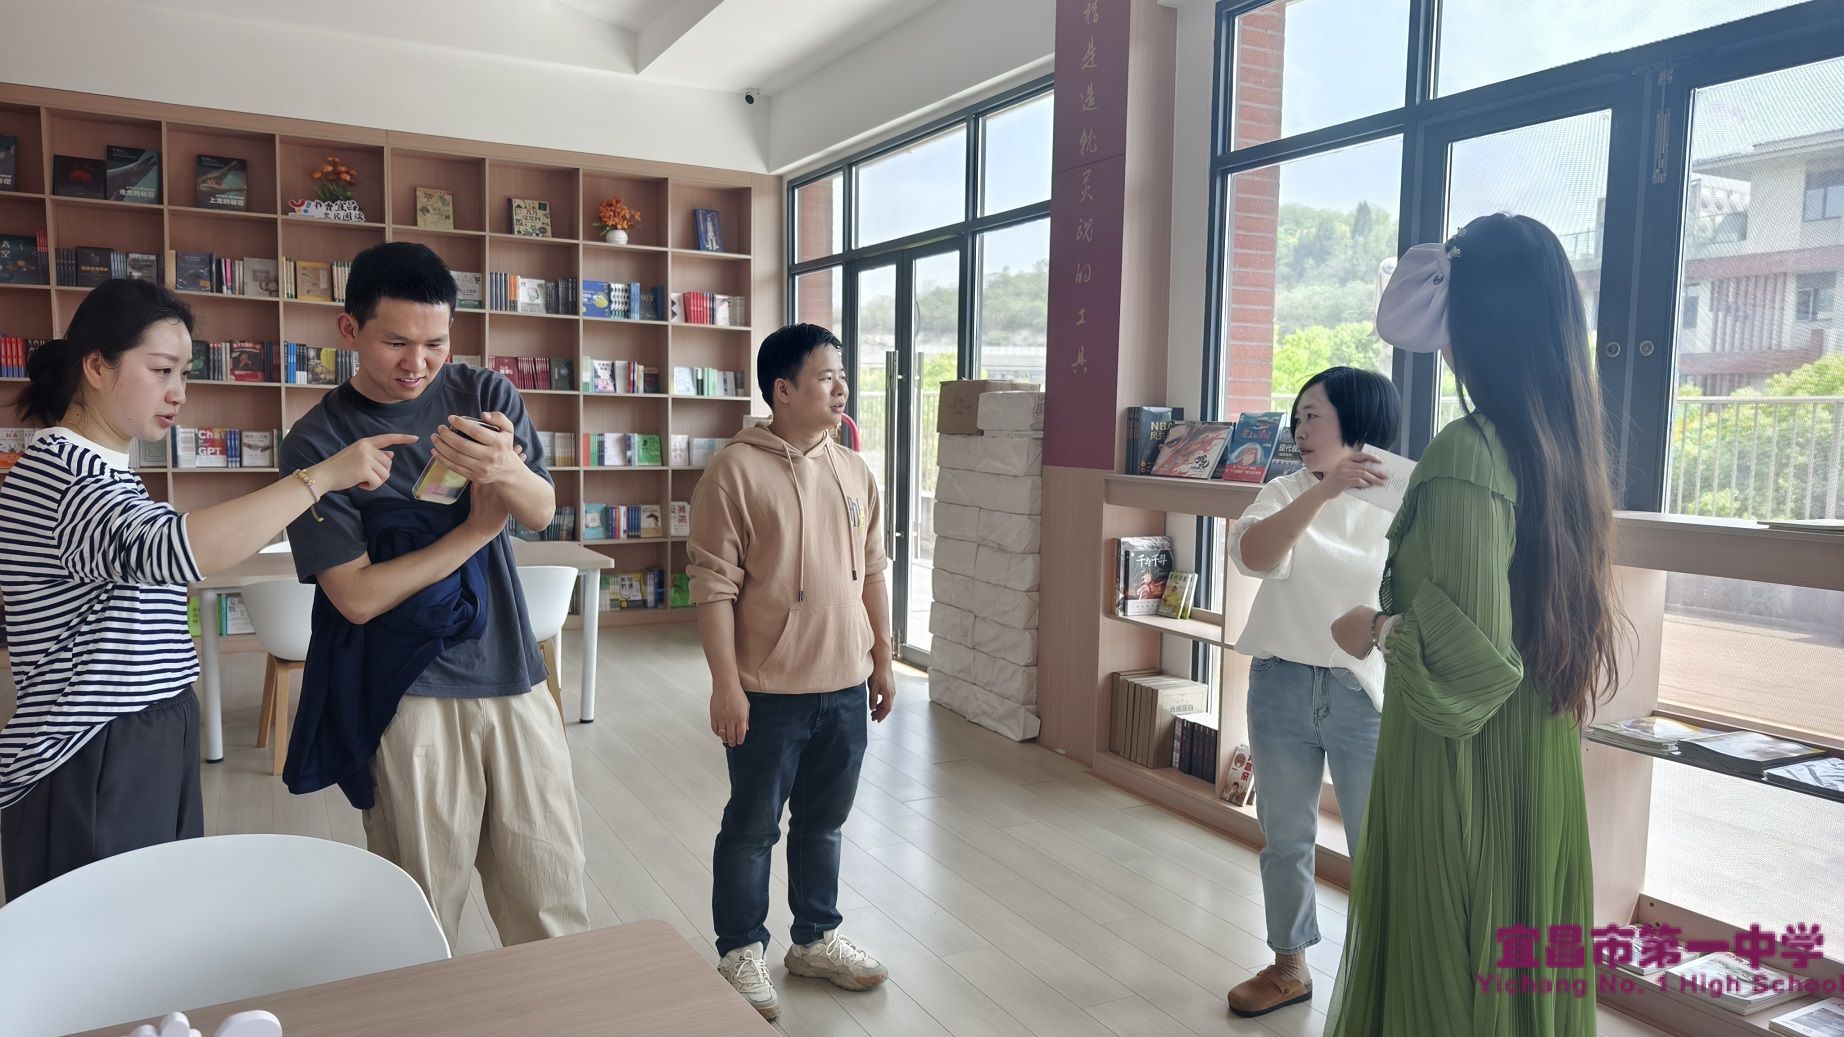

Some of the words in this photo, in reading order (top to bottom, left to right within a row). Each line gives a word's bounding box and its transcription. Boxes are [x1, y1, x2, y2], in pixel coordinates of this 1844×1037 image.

[198, 446, 223, 456] GPT
[1136, 553, 1168, 568] 千与千寻
